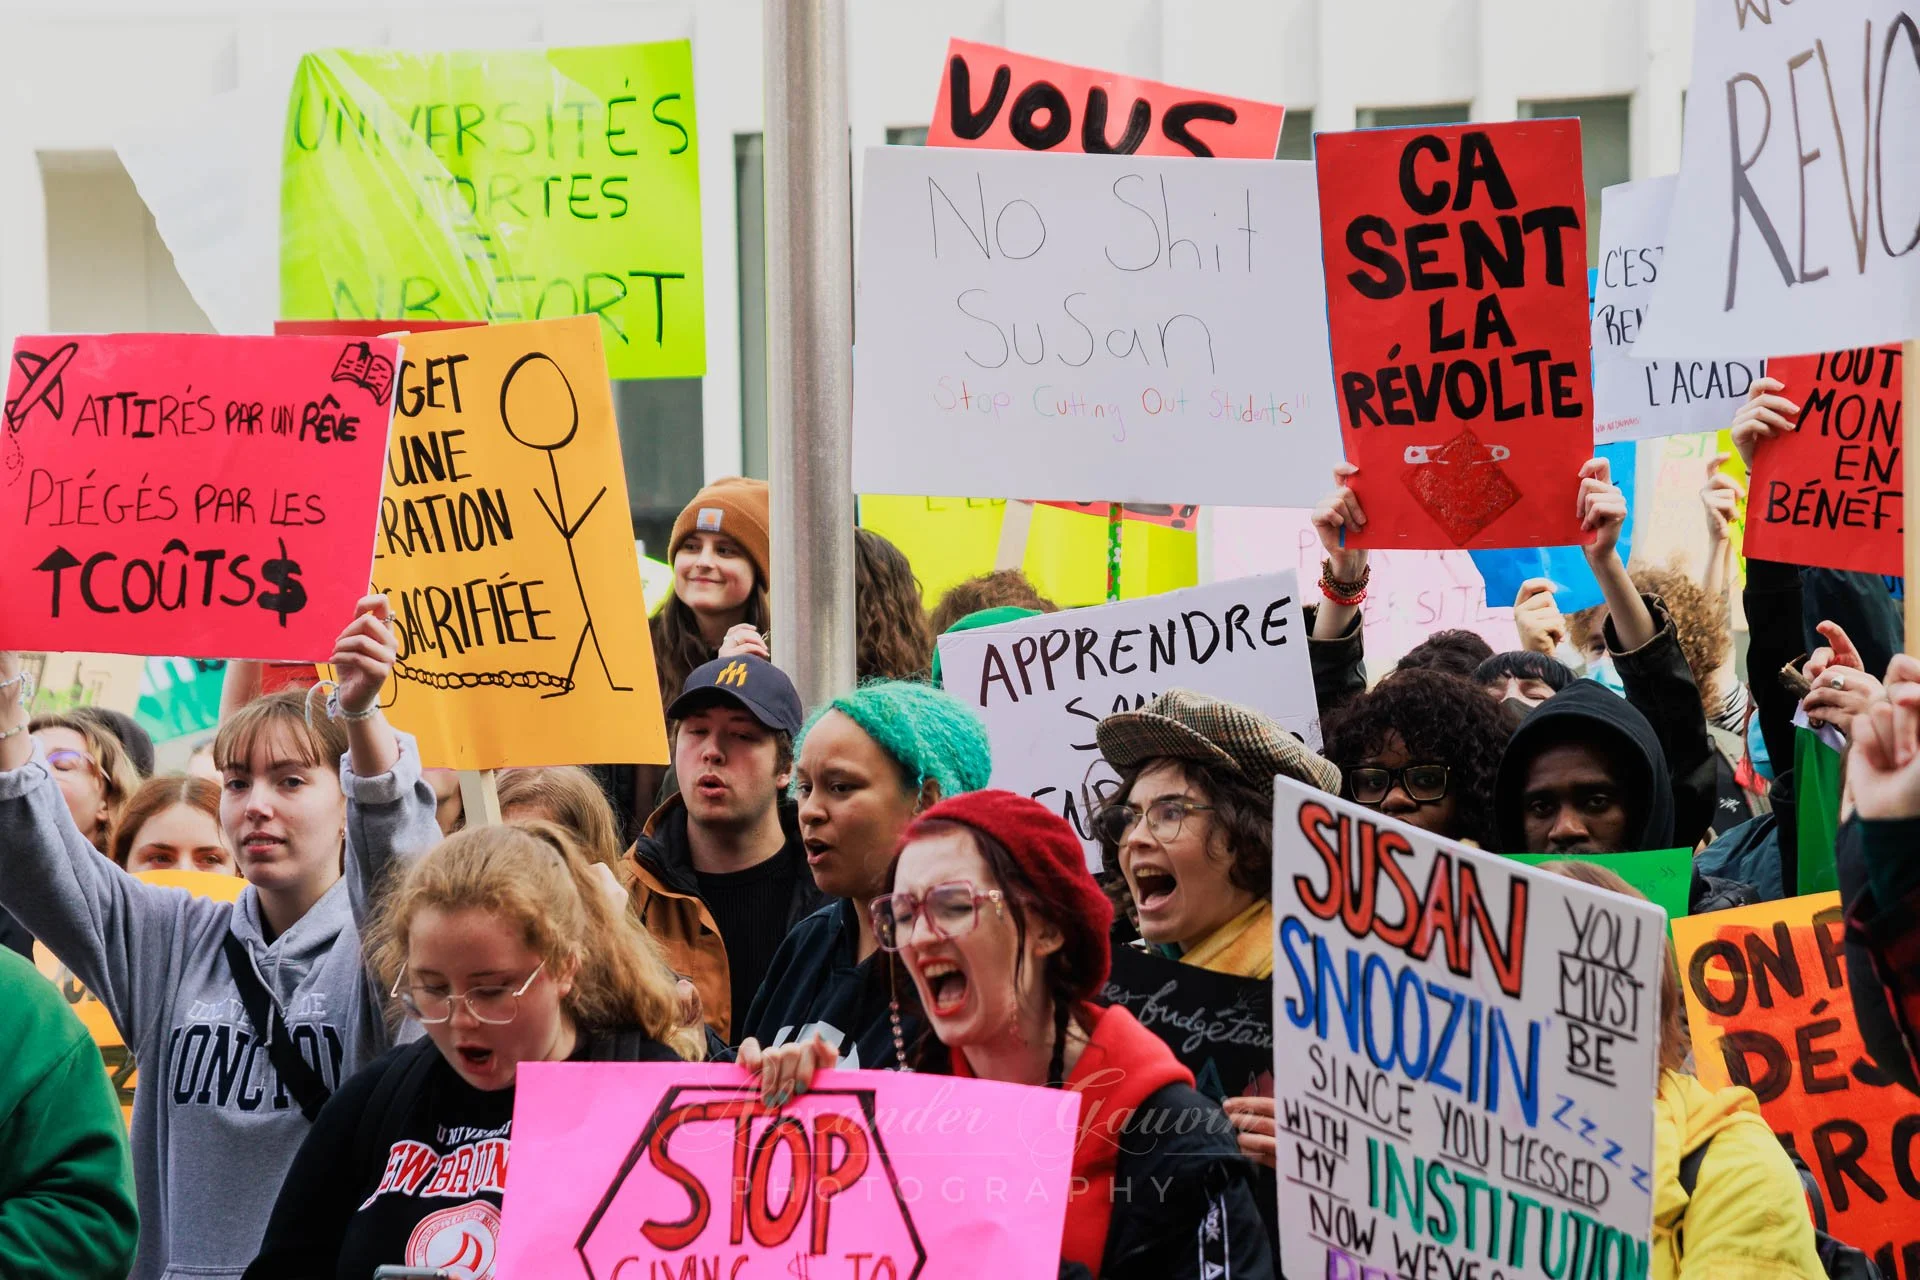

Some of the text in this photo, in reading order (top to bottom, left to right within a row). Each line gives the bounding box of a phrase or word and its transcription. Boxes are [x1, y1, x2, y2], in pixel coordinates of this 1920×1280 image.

[294, 76, 688, 159] UNIVERSITÉS
[950, 54, 1237, 158] VOUS
[1399, 131, 1517, 216] CA
[1104, 173, 1258, 273] Shit
[1345, 206, 1580, 300] SENT
[1428, 293, 1517, 353] LA
[72, 385, 361, 443] ATTIRÉS PAR UN RÊVE
[394, 354, 469, 418] GET
[933, 375, 1012, 419] Stop
[1142, 387, 1189, 415] Out
[1341, 343, 1583, 429] RÉVOLTE
[1795, 388, 1901, 447] MON
[25, 468, 326, 527] PIÉGÉS PAR LES
[1834, 445, 1900, 485] EN
[1764, 479, 1904, 533] BÉNÉF
[979, 596, 1292, 708] APPRENDRE
[1294, 799, 1529, 999] SUSAN
[1564, 895, 1641, 976] YOU
[1559, 956, 1644, 1034] MUST
[1688, 920, 1804, 1017] ON
[169, 1022, 345, 1113] ONCON
[1568, 1021, 1615, 1076] BE
[1283, 1098, 1348, 1156] WITH
[1309, 1044, 1610, 1208] SINCE YOU MESSED
[357, 1140, 441, 1212] EW
[640, 1099, 870, 1256] STOP
[1295, 1143, 1337, 1189] MY
[1309, 1194, 1377, 1255] NOW
[1365, 1136, 1649, 1280] INSTITUTION
